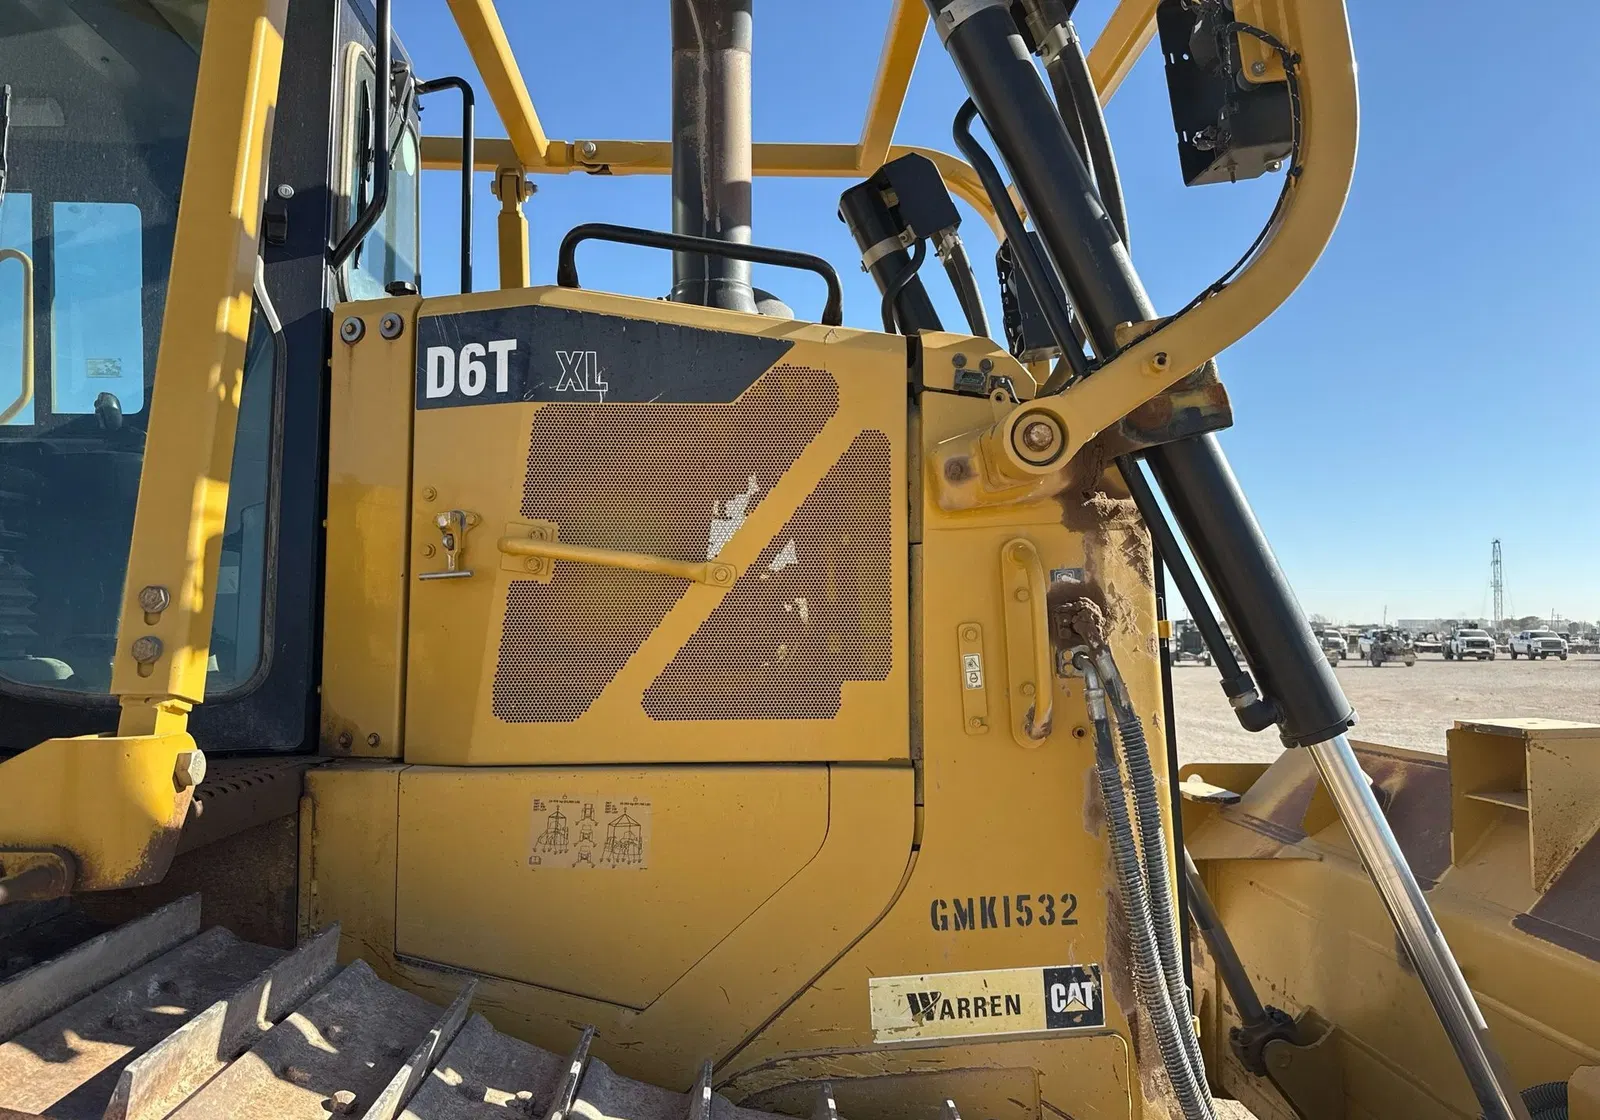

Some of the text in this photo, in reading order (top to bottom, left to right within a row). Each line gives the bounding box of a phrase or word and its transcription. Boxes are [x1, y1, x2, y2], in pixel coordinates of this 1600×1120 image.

[426, 338, 609, 399] D6T XL
[906, 981, 1094, 1022] WARREN CAT
